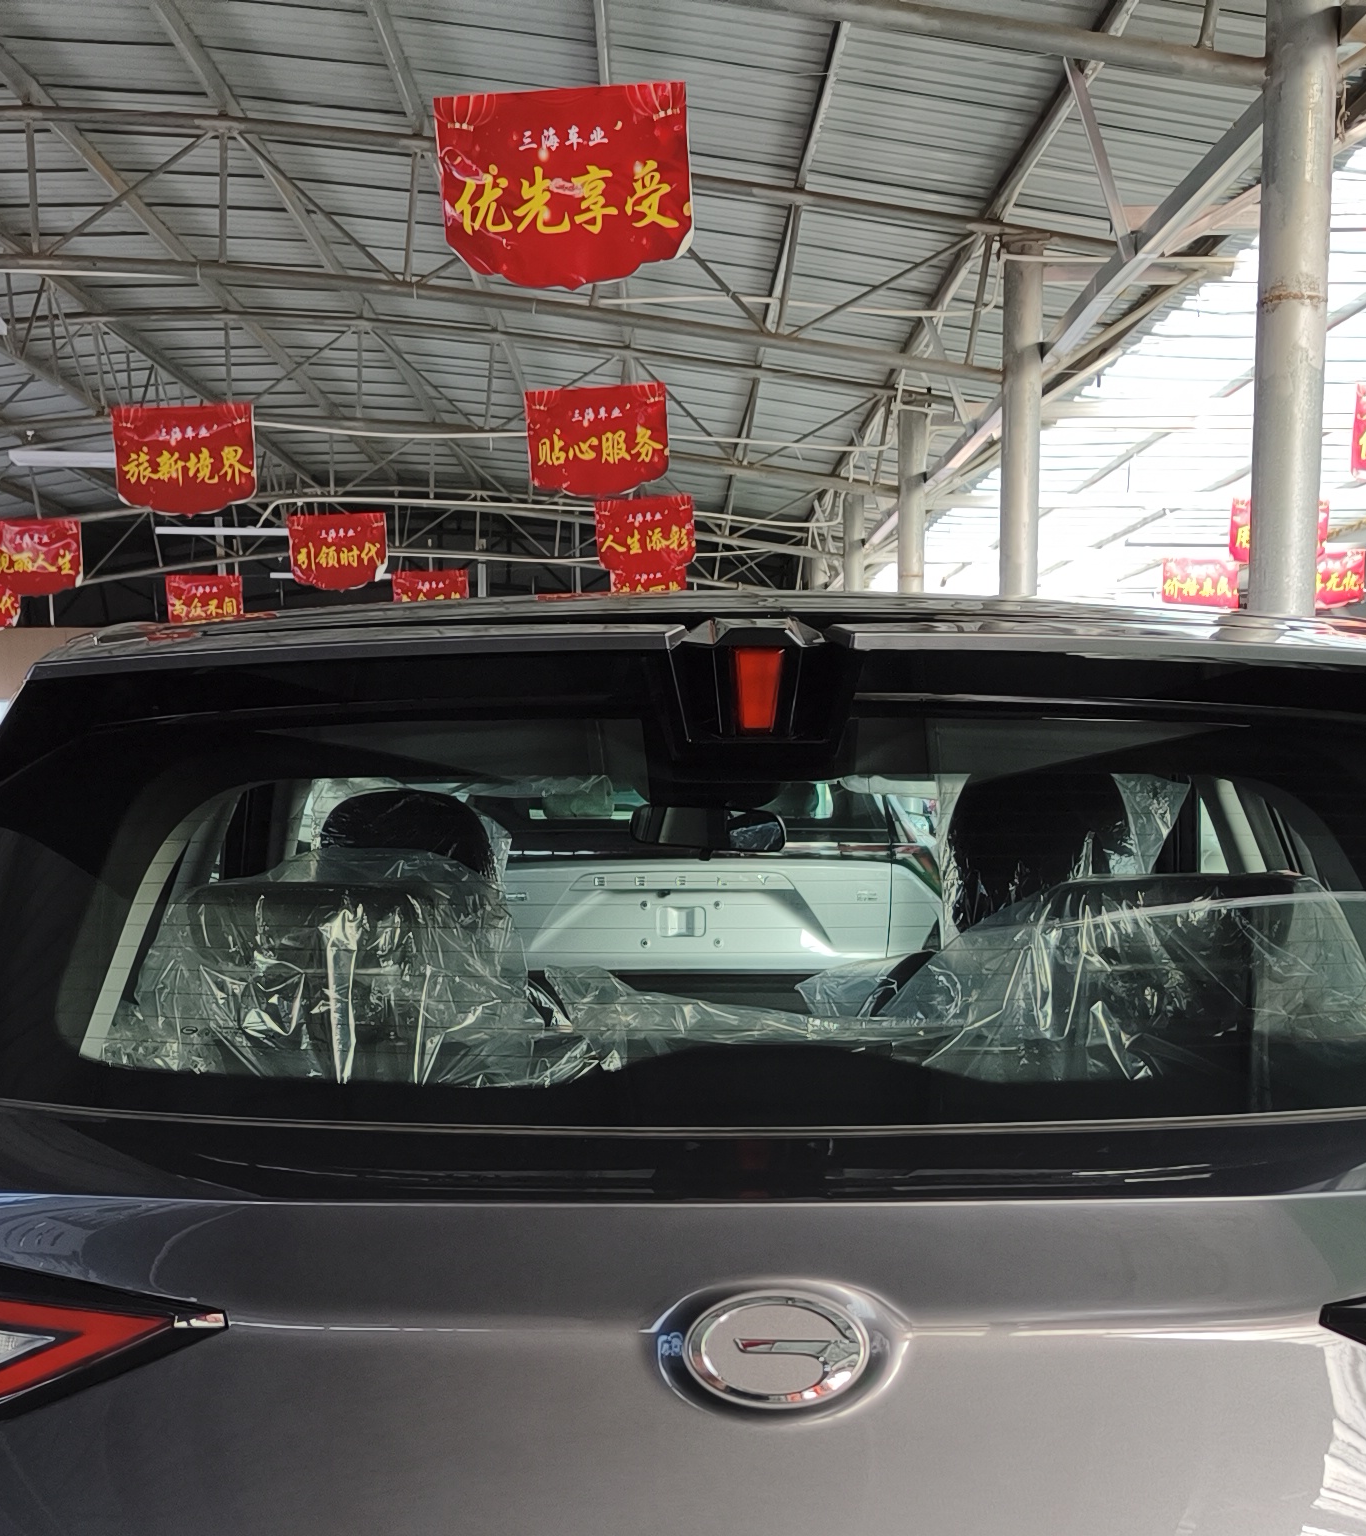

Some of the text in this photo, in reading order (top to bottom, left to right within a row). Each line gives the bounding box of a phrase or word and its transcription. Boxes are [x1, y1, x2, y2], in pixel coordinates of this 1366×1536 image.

[518, 125, 609, 151] 三海车业
[453, 159, 680, 236] 优先享受
[536, 428, 665, 466] 贴心服务
[122, 446, 254, 487] 旅新境界
[296, 541, 382, 574] 引领时代
[600, 525, 691, 555] 人生添彩
